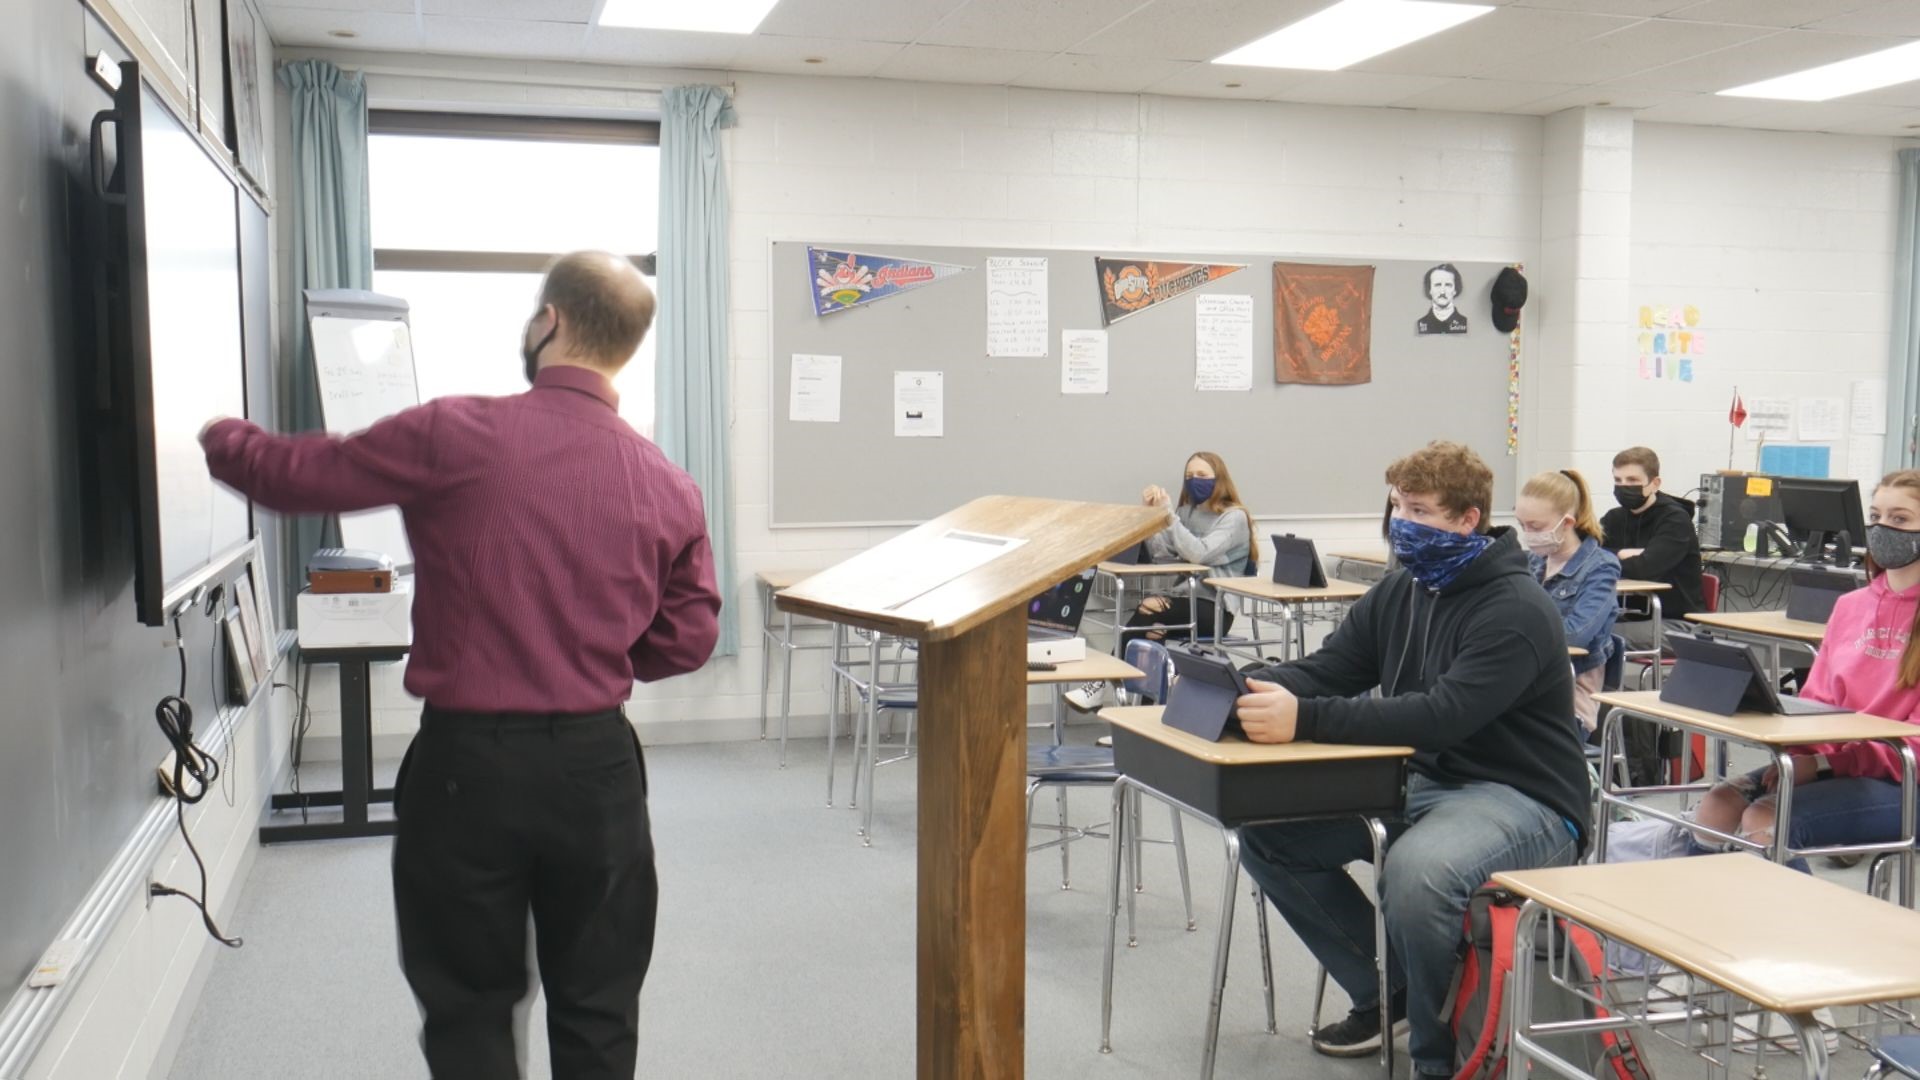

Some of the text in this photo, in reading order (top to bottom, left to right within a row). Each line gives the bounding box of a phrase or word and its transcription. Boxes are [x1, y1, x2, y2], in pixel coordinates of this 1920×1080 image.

[871, 263, 936, 289] Indians
[1152, 266, 1210, 303] BUCKEYES
[1638, 304, 1701, 328] READ
[1637, 330, 1706, 355] WRITE
[1638, 356, 1695, 383] LIVE
